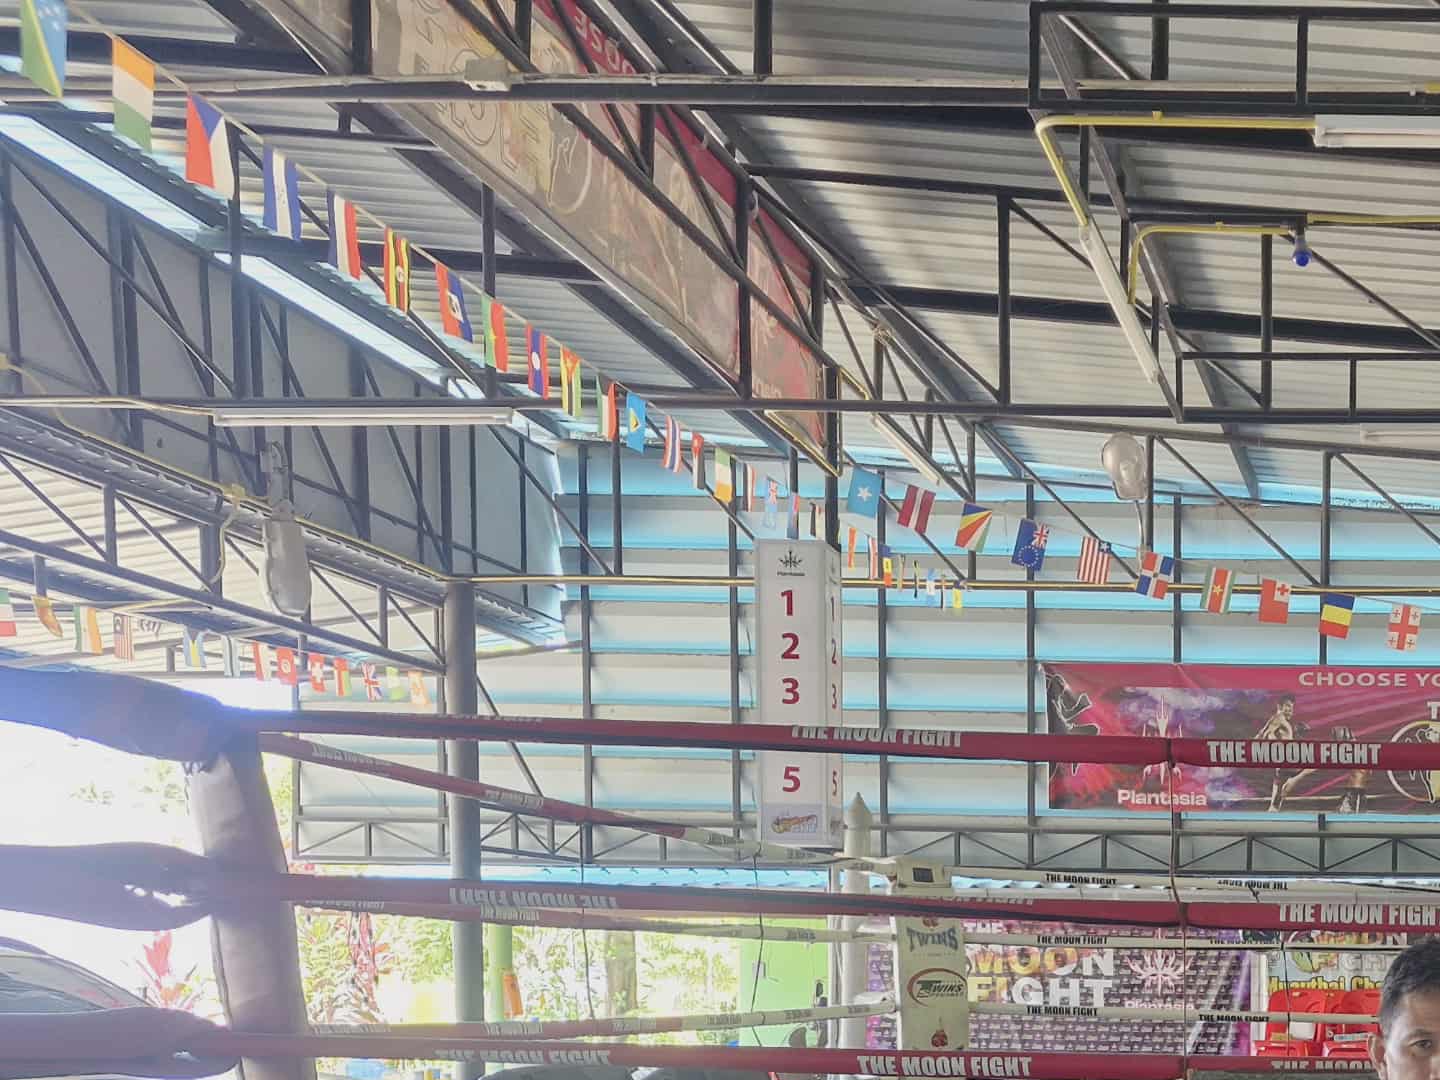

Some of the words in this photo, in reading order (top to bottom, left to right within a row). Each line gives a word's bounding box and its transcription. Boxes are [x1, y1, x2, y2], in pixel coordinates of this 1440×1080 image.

[781, 590, 794, 616] 1
[782, 633, 800, 660] 2
[782, 678, 800, 705] 3
[1299, 672, 1408, 687] CHOOSE
[1207, 741, 1247, 764] THE
[1251, 741, 1314, 764] MOON
[1320, 743, 1382, 765] FIGHT
[782, 766, 800, 793] 5
[1118, 789, 1207, 806] Plantasia
[1047, 873, 1060, 882] THE
[1064, 875, 1089, 883] MOON
[1279, 903, 1316, 922] THE
[1320, 904, 1383, 925] MOON
[906, 926, 958, 952] TWINS
[1037, 936, 1051, 944] THE
[1055, 936, 1080, 944] MOON
[1082, 936, 1107, 945] FIGHT
[965, 944, 1114, 976] MOON
[968, 976, 1112, 1007] FIGHT
[1027, 1006, 1041, 1015] THE
[1045, 1006, 1070, 1016] MOON
[1073, 1007, 1098, 1017] FIGHT
[857, 1055, 896, 1075] THE
[902, 1056, 966, 1076] MOON
[971, 1056, 1032, 1077] FIGHT
